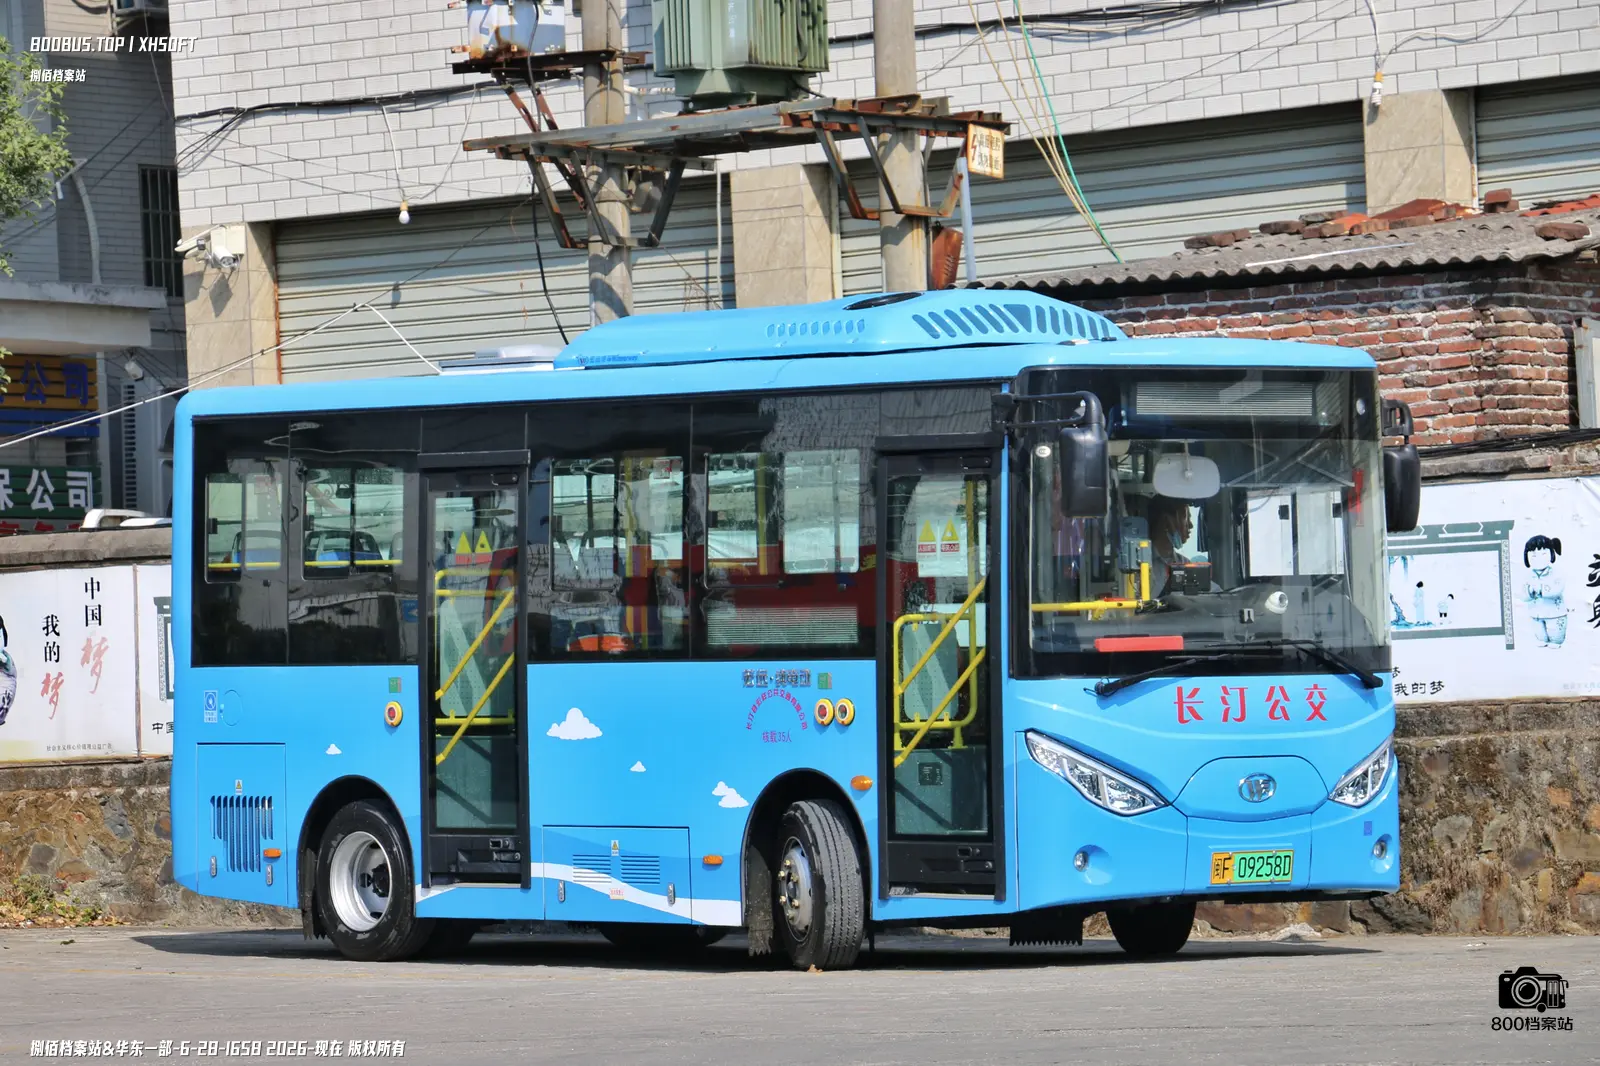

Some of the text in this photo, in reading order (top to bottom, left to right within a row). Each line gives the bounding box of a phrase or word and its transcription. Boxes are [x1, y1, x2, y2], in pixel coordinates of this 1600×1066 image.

[0, 360, 89, 405] 公司
[81, 577, 109, 694] 中国梦
[40, 614, 65, 720] 我的梦
[1394, 680, 1445, 696] 我的梦
[1173, 683, 1329, 724] 长汀公交
